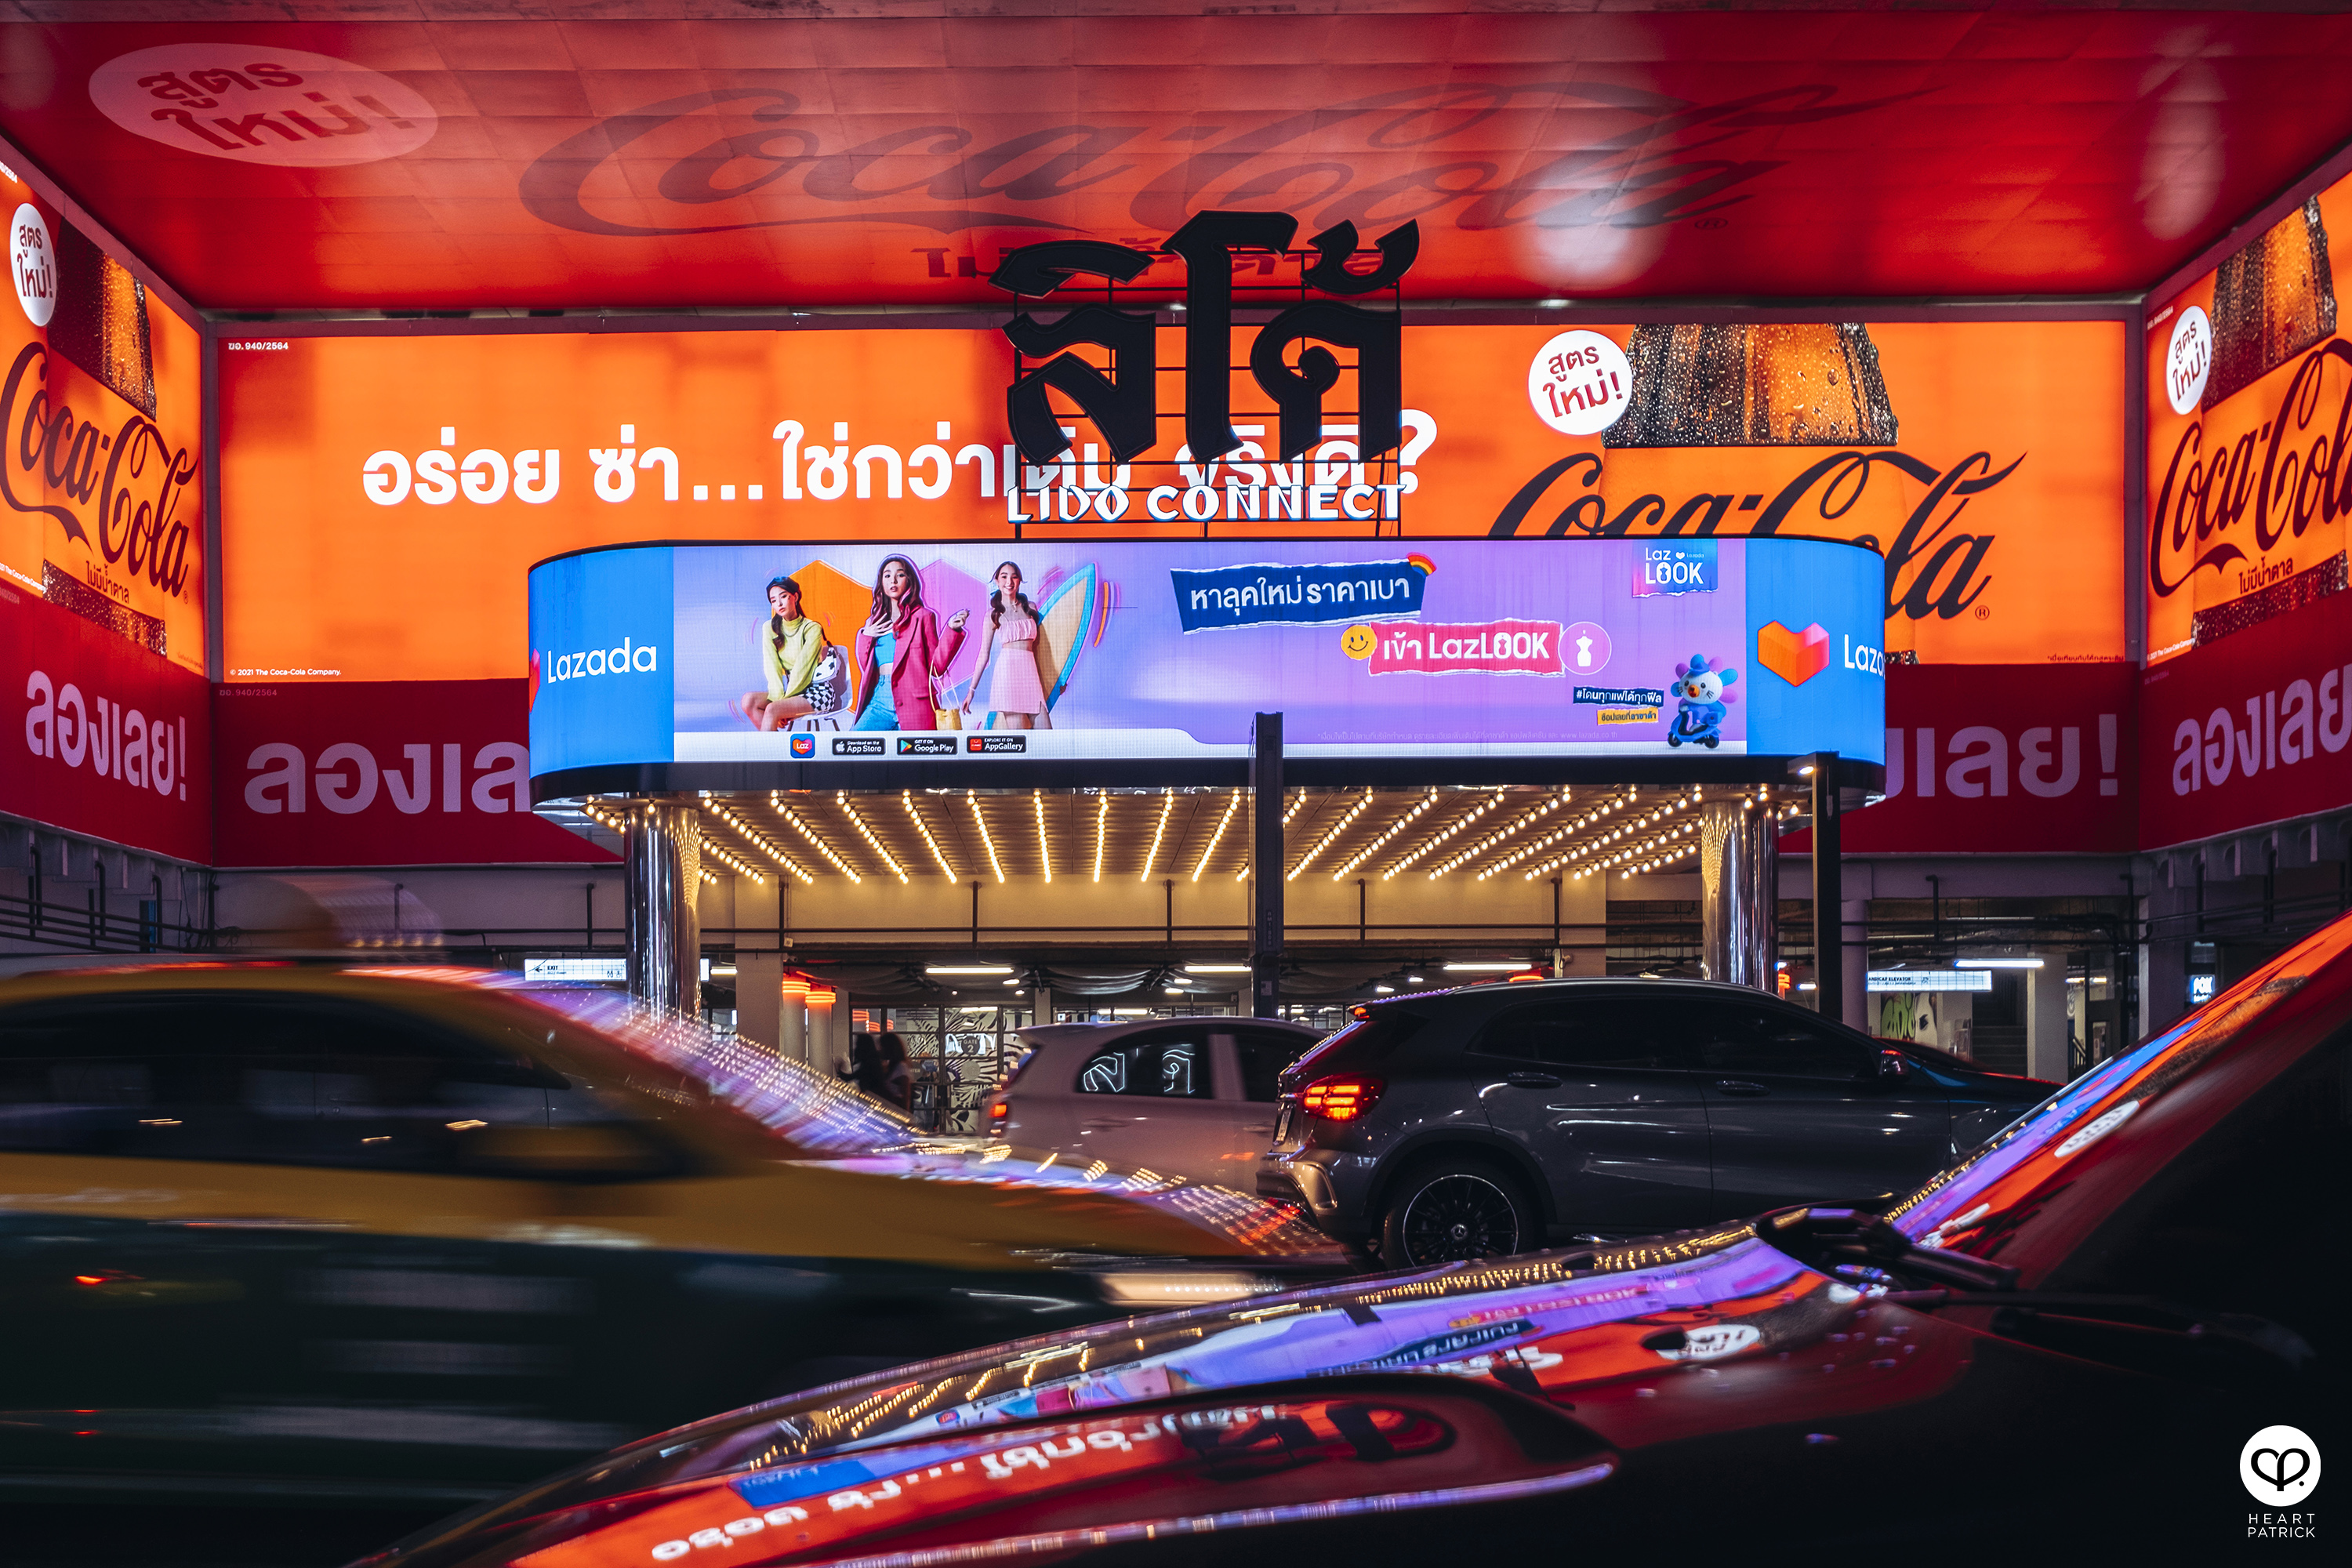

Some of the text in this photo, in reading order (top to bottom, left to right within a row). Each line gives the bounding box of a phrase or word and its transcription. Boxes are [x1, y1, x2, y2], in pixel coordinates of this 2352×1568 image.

[137, 63, 304, 109] สูตร
[151, 92, 416, 151] ใหม่!
[20, 224, 42, 258] สูตร
[17, 252, 53, 299] ใหม่!
[1548, 341, 1600, 383] สูตร
[2175, 320, 2197, 365] สูตร
[2172, 339, 2207, 401] ใหม่!
[1541, 371, 1624, 419] ใหม่!
[0, 342, 198, 597] Coca-Cola
[363, 426, 561, 506] อร่อย
[2151, 338, 2352, 597] Coca-Col
[1008, 484, 1407, 524] LIDO CONNECT
[1645, 561, 1704, 585] LOOK
[1646, 547, 1671, 561] Laz
[2238, 555, 2294, 595] ไม่มีน้ำตาล
[85, 560, 129, 604] ไม่มีน้ำตาล
[548, 636, 658, 684] Lazada
[1384, 631, 1422, 660] เข้า
[1844, 634, 1886, 680] Laza
[26, 670, 187, 801] ลองเลย!
[847, 745, 862, 753] App
[914, 744, 954, 753] Google Play
[984, 742, 1023, 752] AppGallery
[244, 741, 532, 815] ลองเล
[967, 1044, 975, 1053] 2
